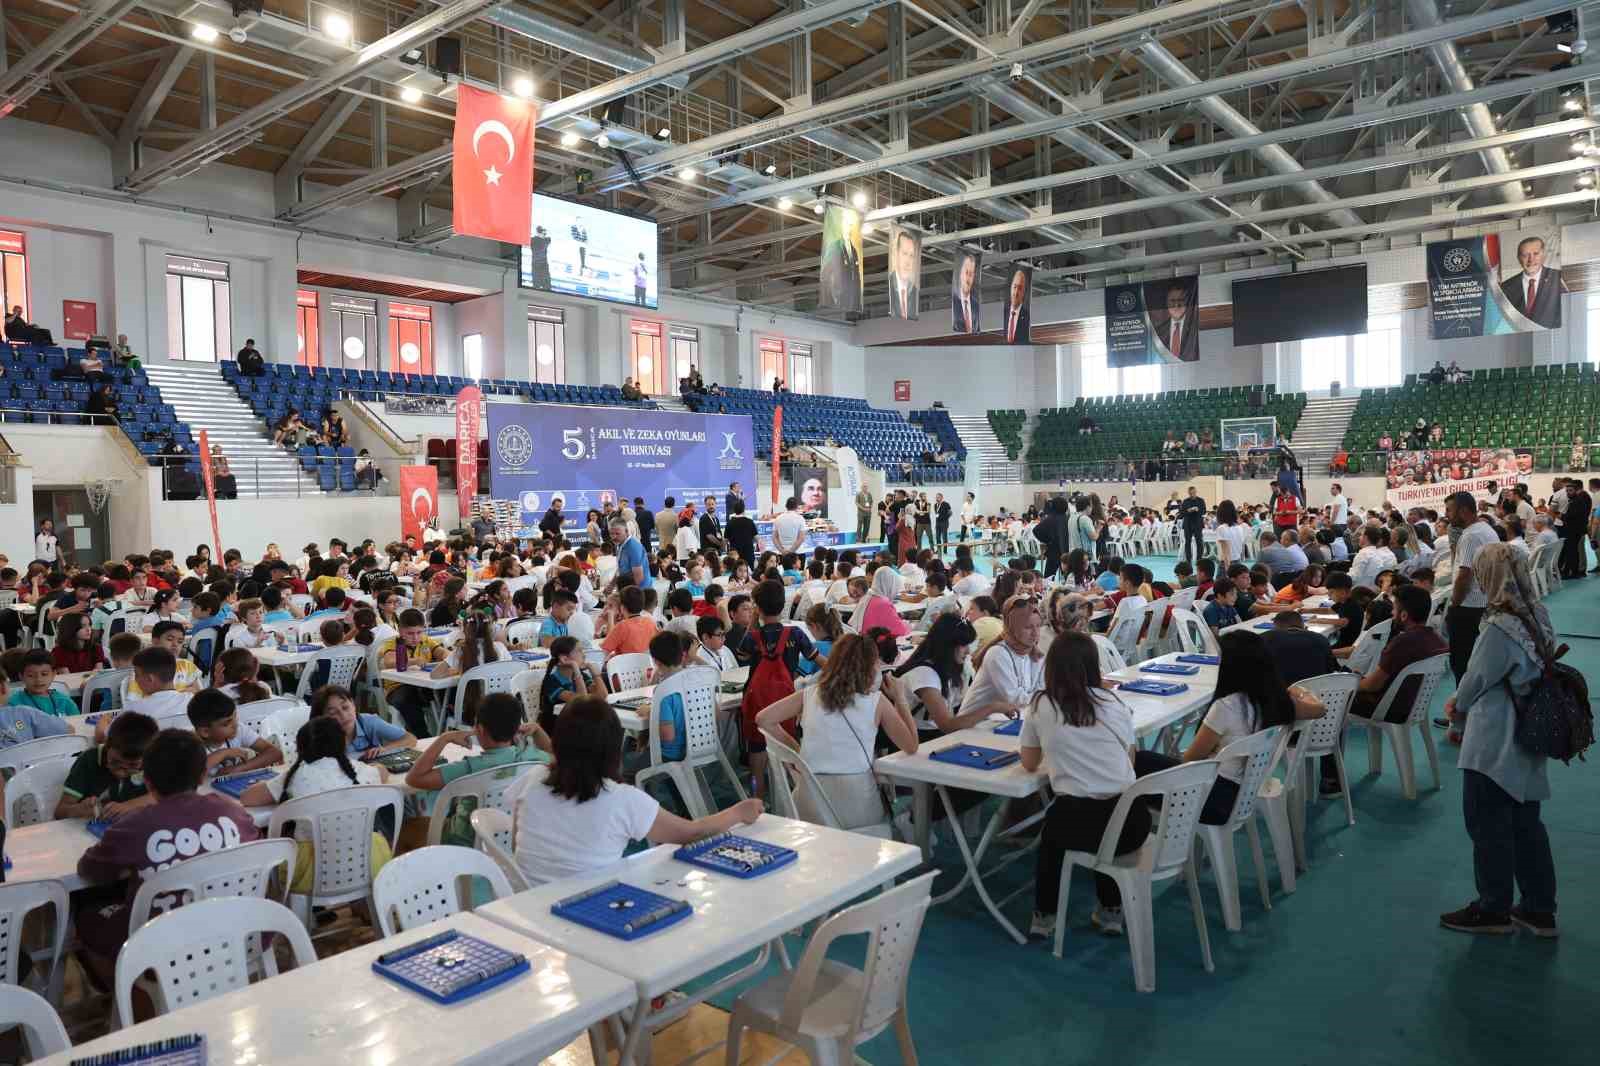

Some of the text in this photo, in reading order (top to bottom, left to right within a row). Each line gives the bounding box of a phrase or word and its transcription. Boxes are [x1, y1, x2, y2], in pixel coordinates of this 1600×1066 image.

[459, 400, 471, 465] DARICA
[561, 426, 590, 460] 5.
[599, 428, 706, 442] AKIL VE ZEKA OYUNLARI
[620, 445, 672, 457] TURNUVASI
[146, 816, 241, 863] GOOD
